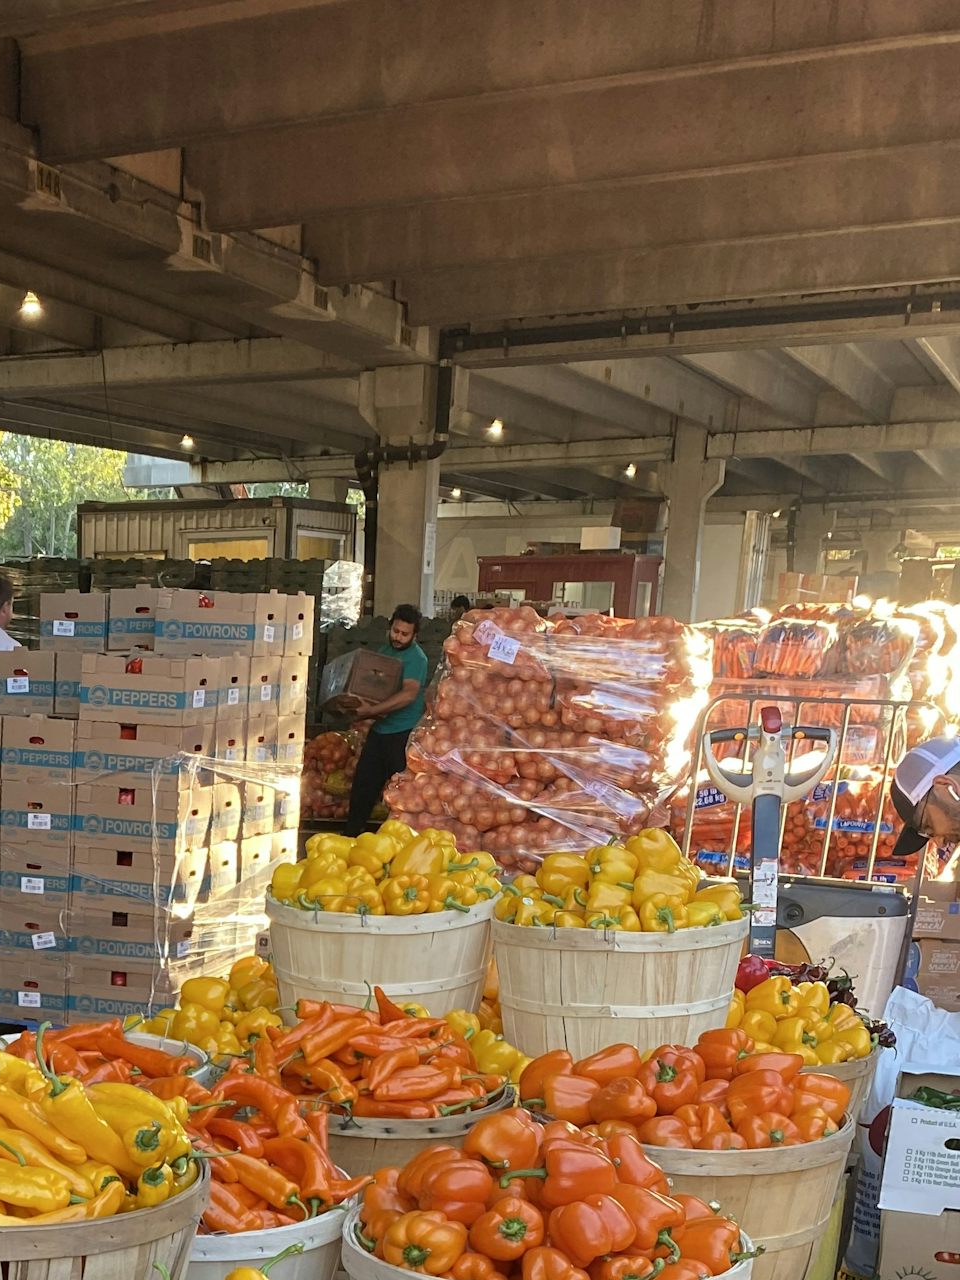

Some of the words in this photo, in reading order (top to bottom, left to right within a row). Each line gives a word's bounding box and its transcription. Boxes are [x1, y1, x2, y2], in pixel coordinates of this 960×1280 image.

[185, 623, 248, 639] POIVRONS
[112, 689, 177, 707] PEPPERS
[22, 752, 69, 766] PEPPERS
[700, 788, 709, 797] 50
[710, 787, 718, 796] lb
[715, 793, 725, 804] kg
[22, 812, 68, 829] PONS
[840, 820, 868, 829] LAPOINTE
[105, 821, 169, 837] POIVRONS
[920, 1118, 937, 1126] Product
